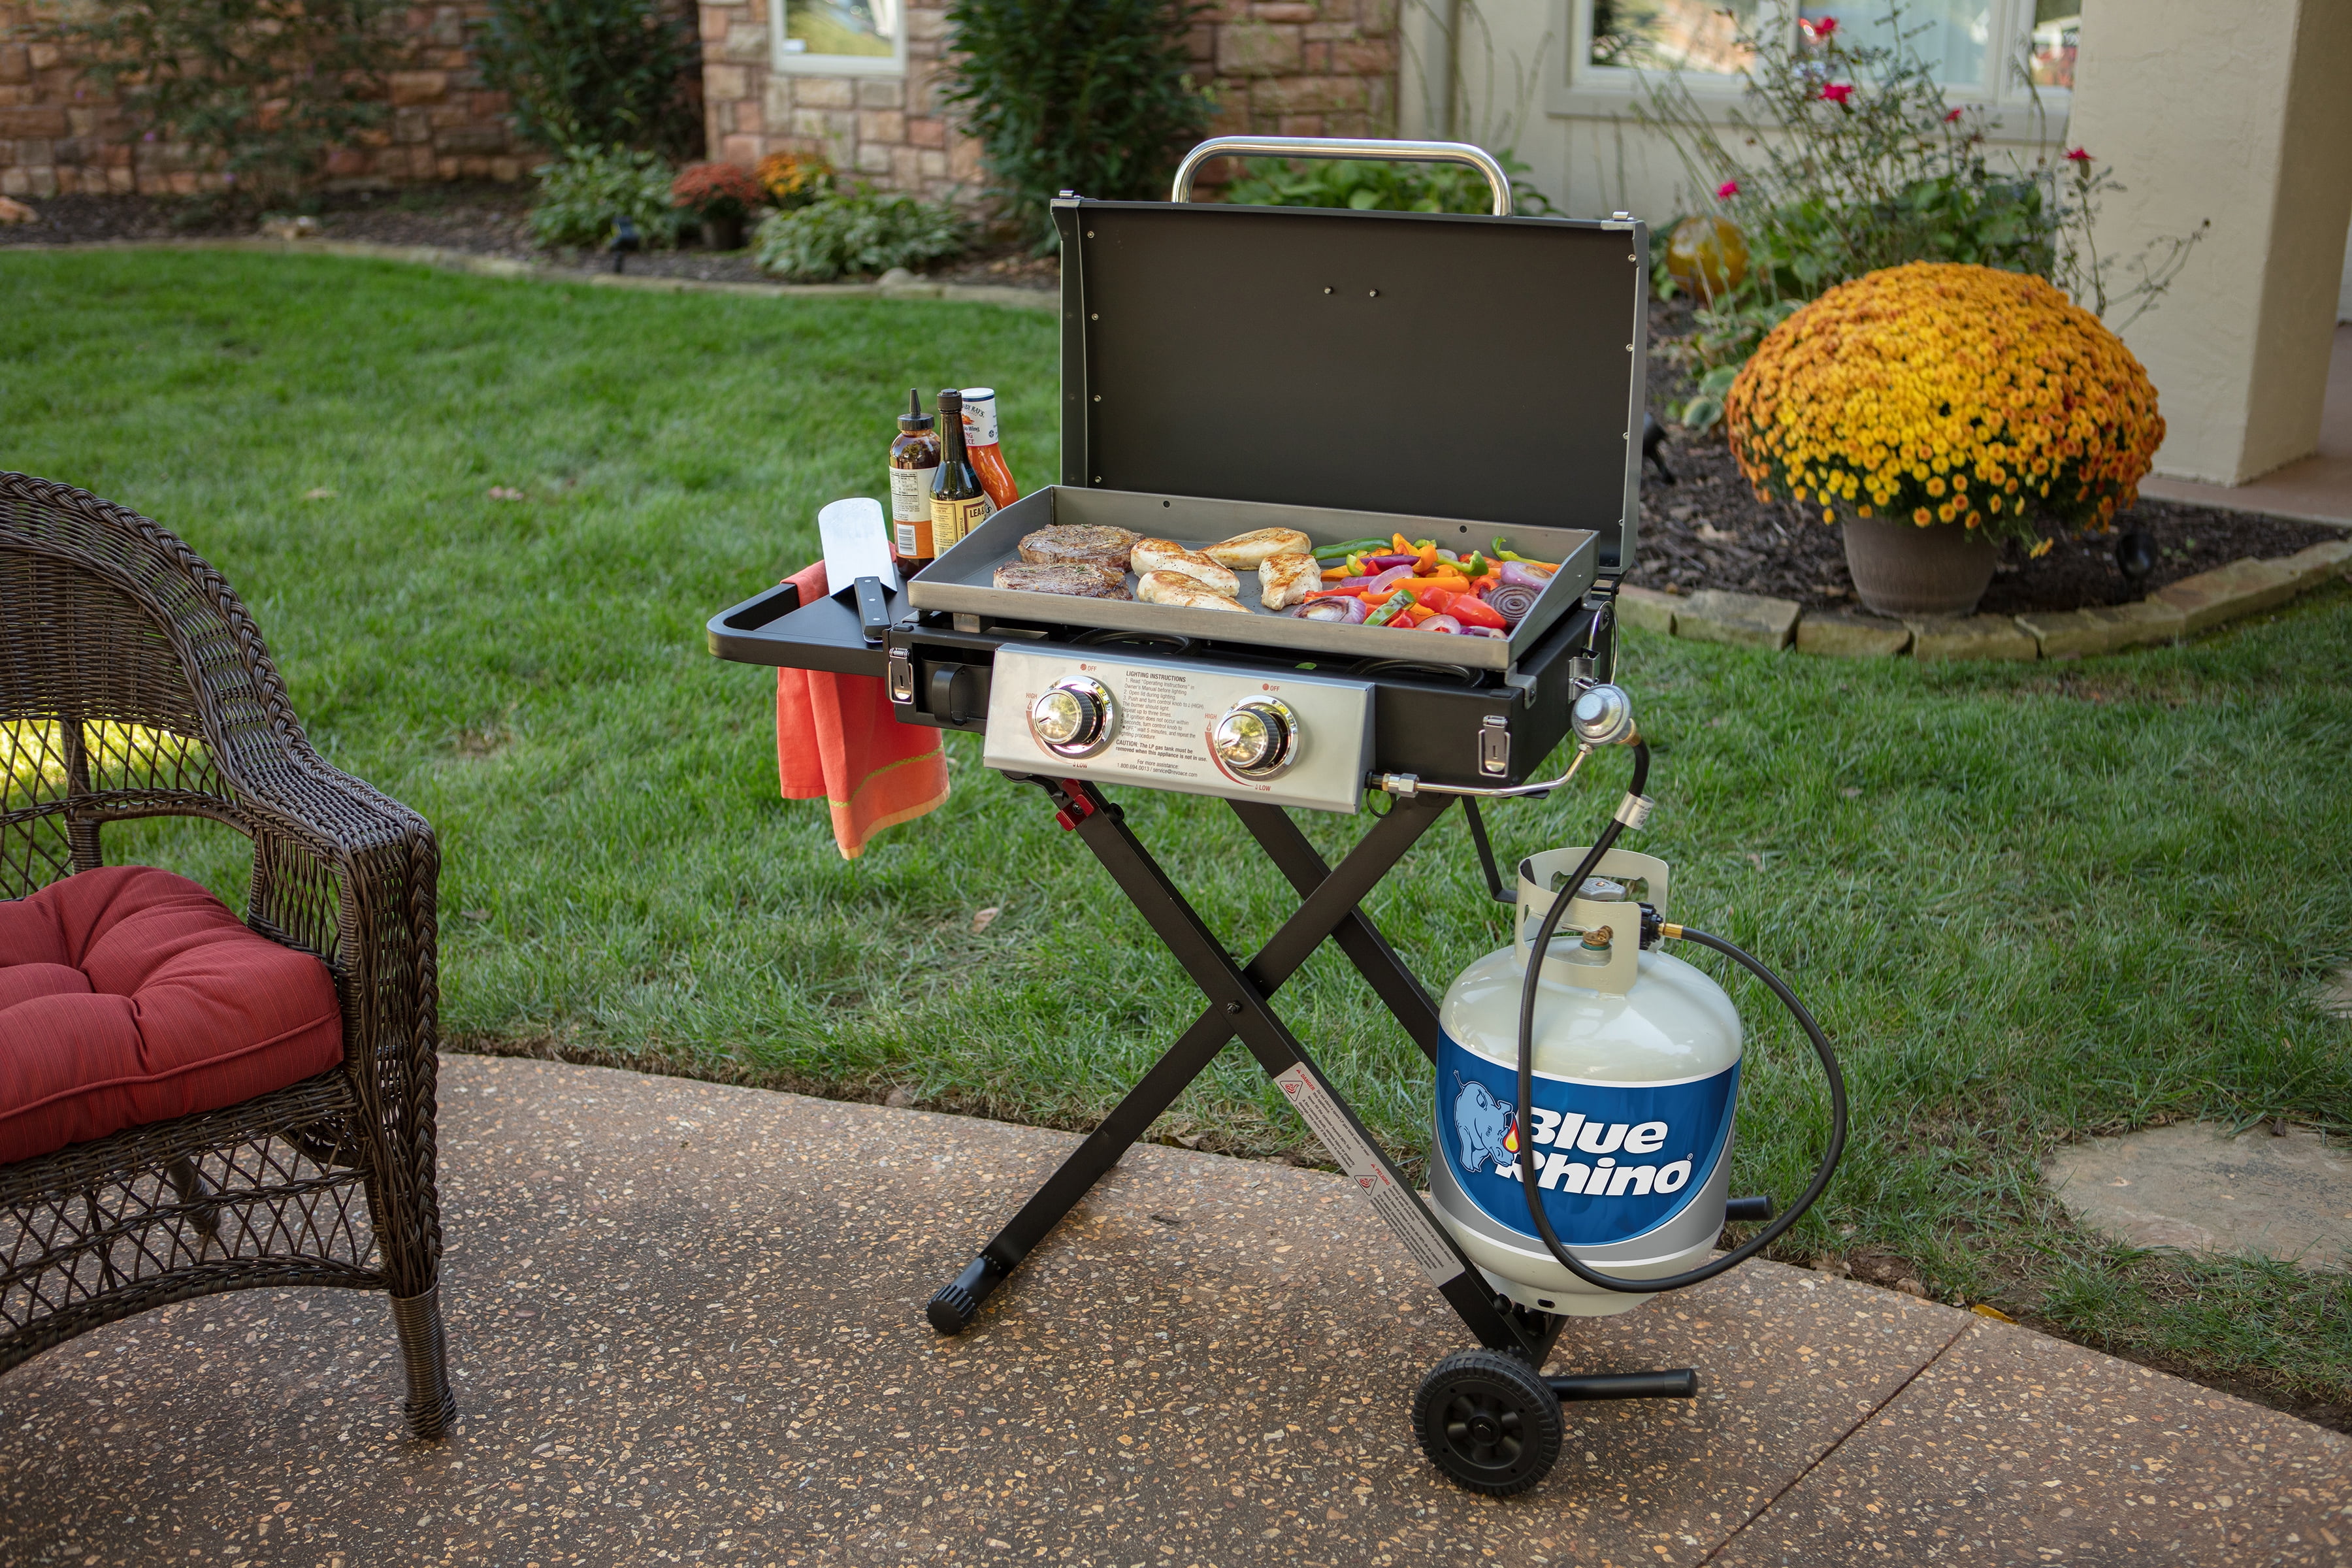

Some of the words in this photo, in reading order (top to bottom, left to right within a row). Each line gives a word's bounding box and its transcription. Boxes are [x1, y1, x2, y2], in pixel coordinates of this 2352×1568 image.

[1150, 673, 1186, 682] INSTRUCTIONS
[1299, 1073, 1315, 1091] DANGER
[1307, 1095, 1316, 1105] Never
[1331, 1110, 1340, 1119] spare
[1516, 1106, 1668, 1154] Blue
[1375, 1168, 1390, 1186] PELIGRO
